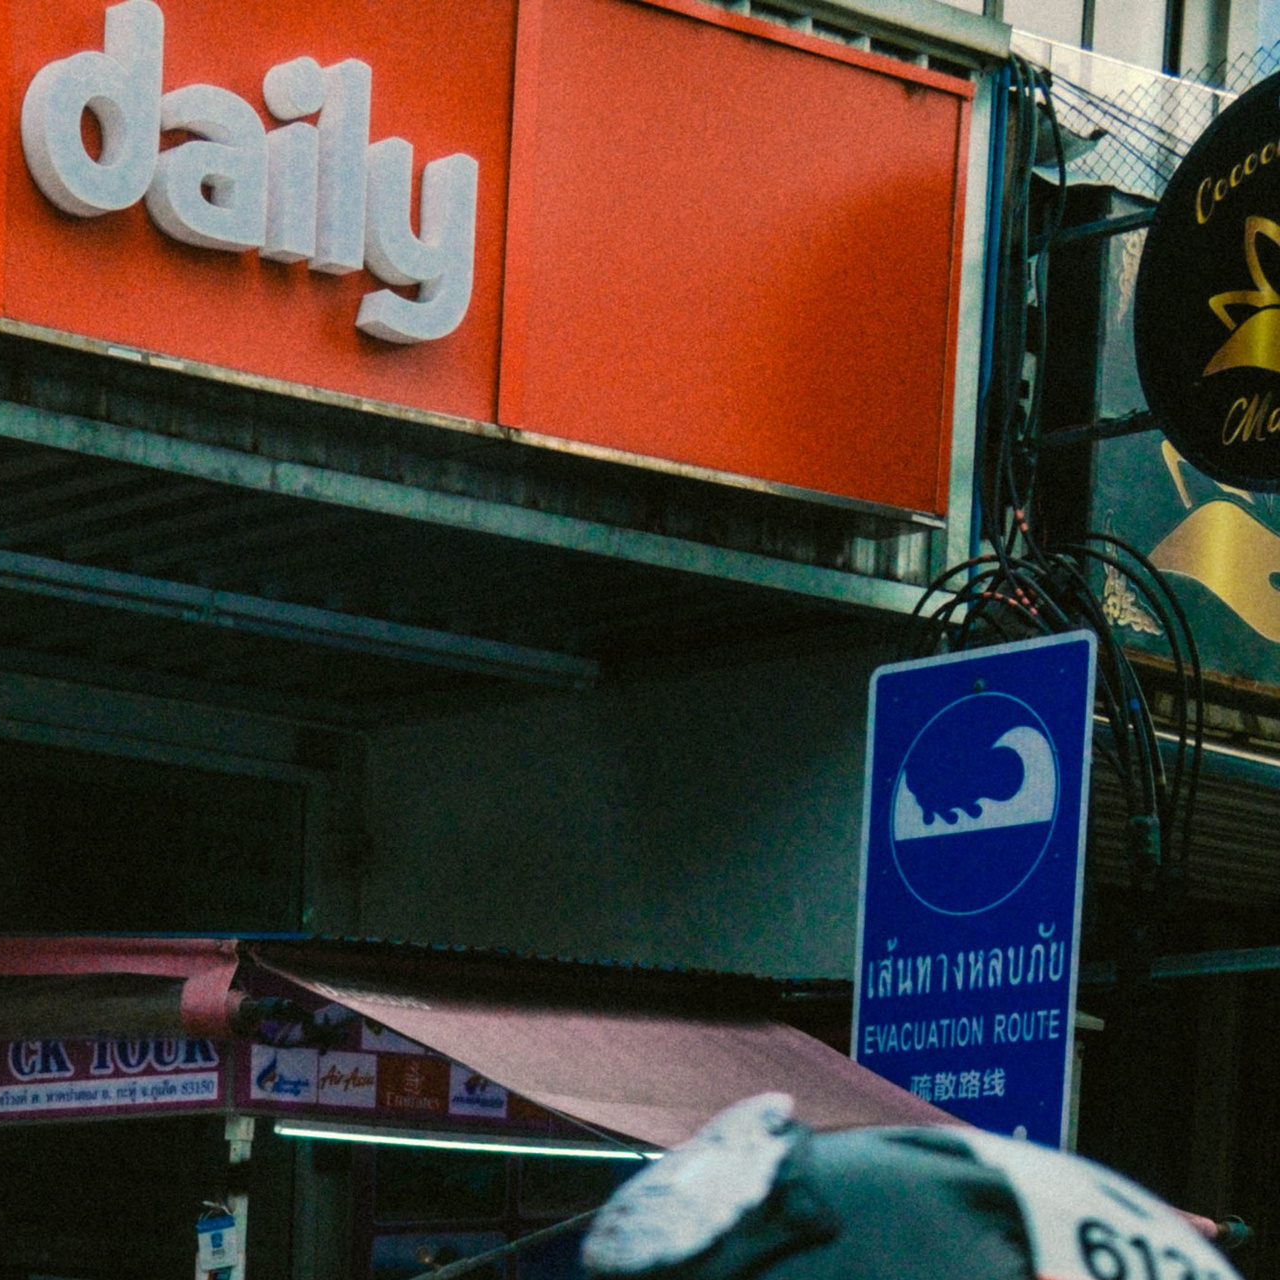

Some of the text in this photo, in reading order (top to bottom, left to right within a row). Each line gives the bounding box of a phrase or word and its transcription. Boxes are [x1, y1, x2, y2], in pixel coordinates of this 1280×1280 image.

[23, 0, 479, 345] daily
[1195, 140, 1280, 225] Cocoo
[867, 921, 1066, 999] เส้นทางหลบภัย
[864, 1009, 1061, 1055] EVACUATION ROUTE
[9, 1037, 74, 1081] CK
[181, 1078, 215, 1096] 83150
[910, 1067, 1007, 1102] 疏散路线
